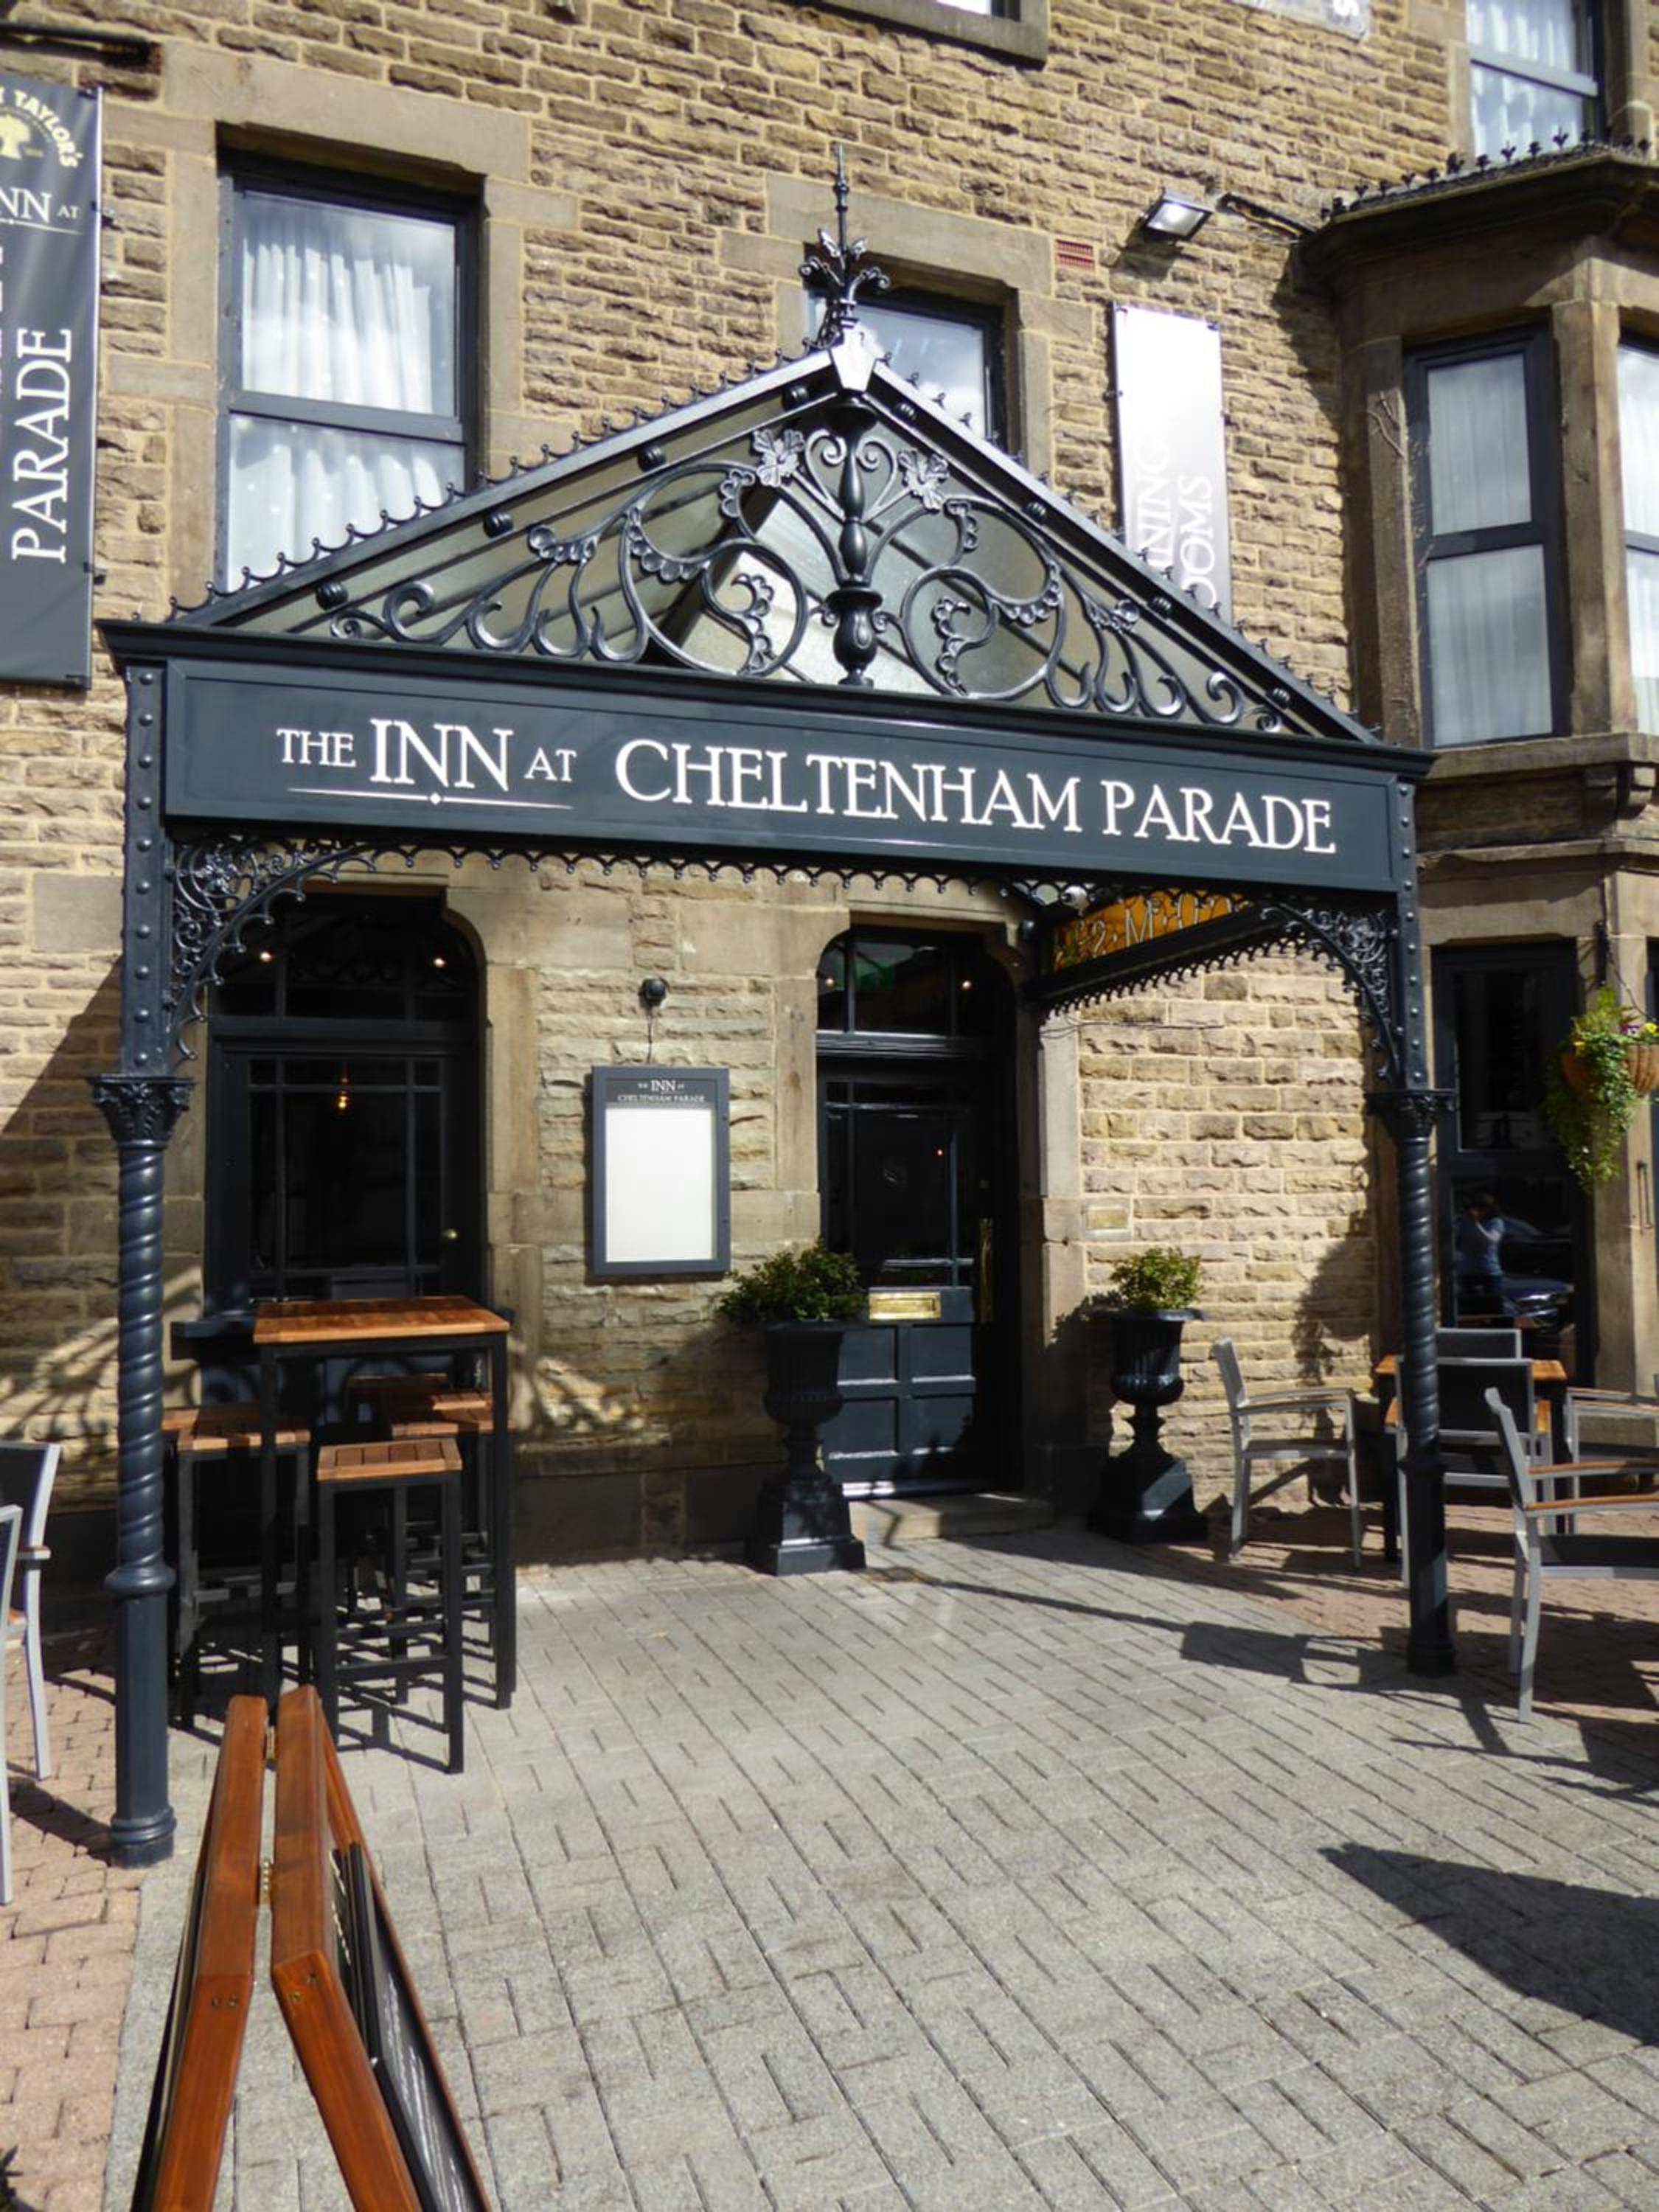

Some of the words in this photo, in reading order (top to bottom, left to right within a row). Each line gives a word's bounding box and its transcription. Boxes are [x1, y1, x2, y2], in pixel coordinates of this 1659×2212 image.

[14, 89, 83, 167] TAYLOR'S
[0, 187, 52, 222] NN
[57, 204, 80, 220] AT
[12, 327, 72, 563] PARADE
[1178, 474, 1217, 609] OOMS
[276, 728, 356, 768] THE
[369, 717, 514, 792] INN
[524, 747, 577, 782] AT
[615, 739, 1082, 832] CHELTENHAM
[1100, 779, 1336, 854] PARADE
[650, 1079, 677, 1092] INN
